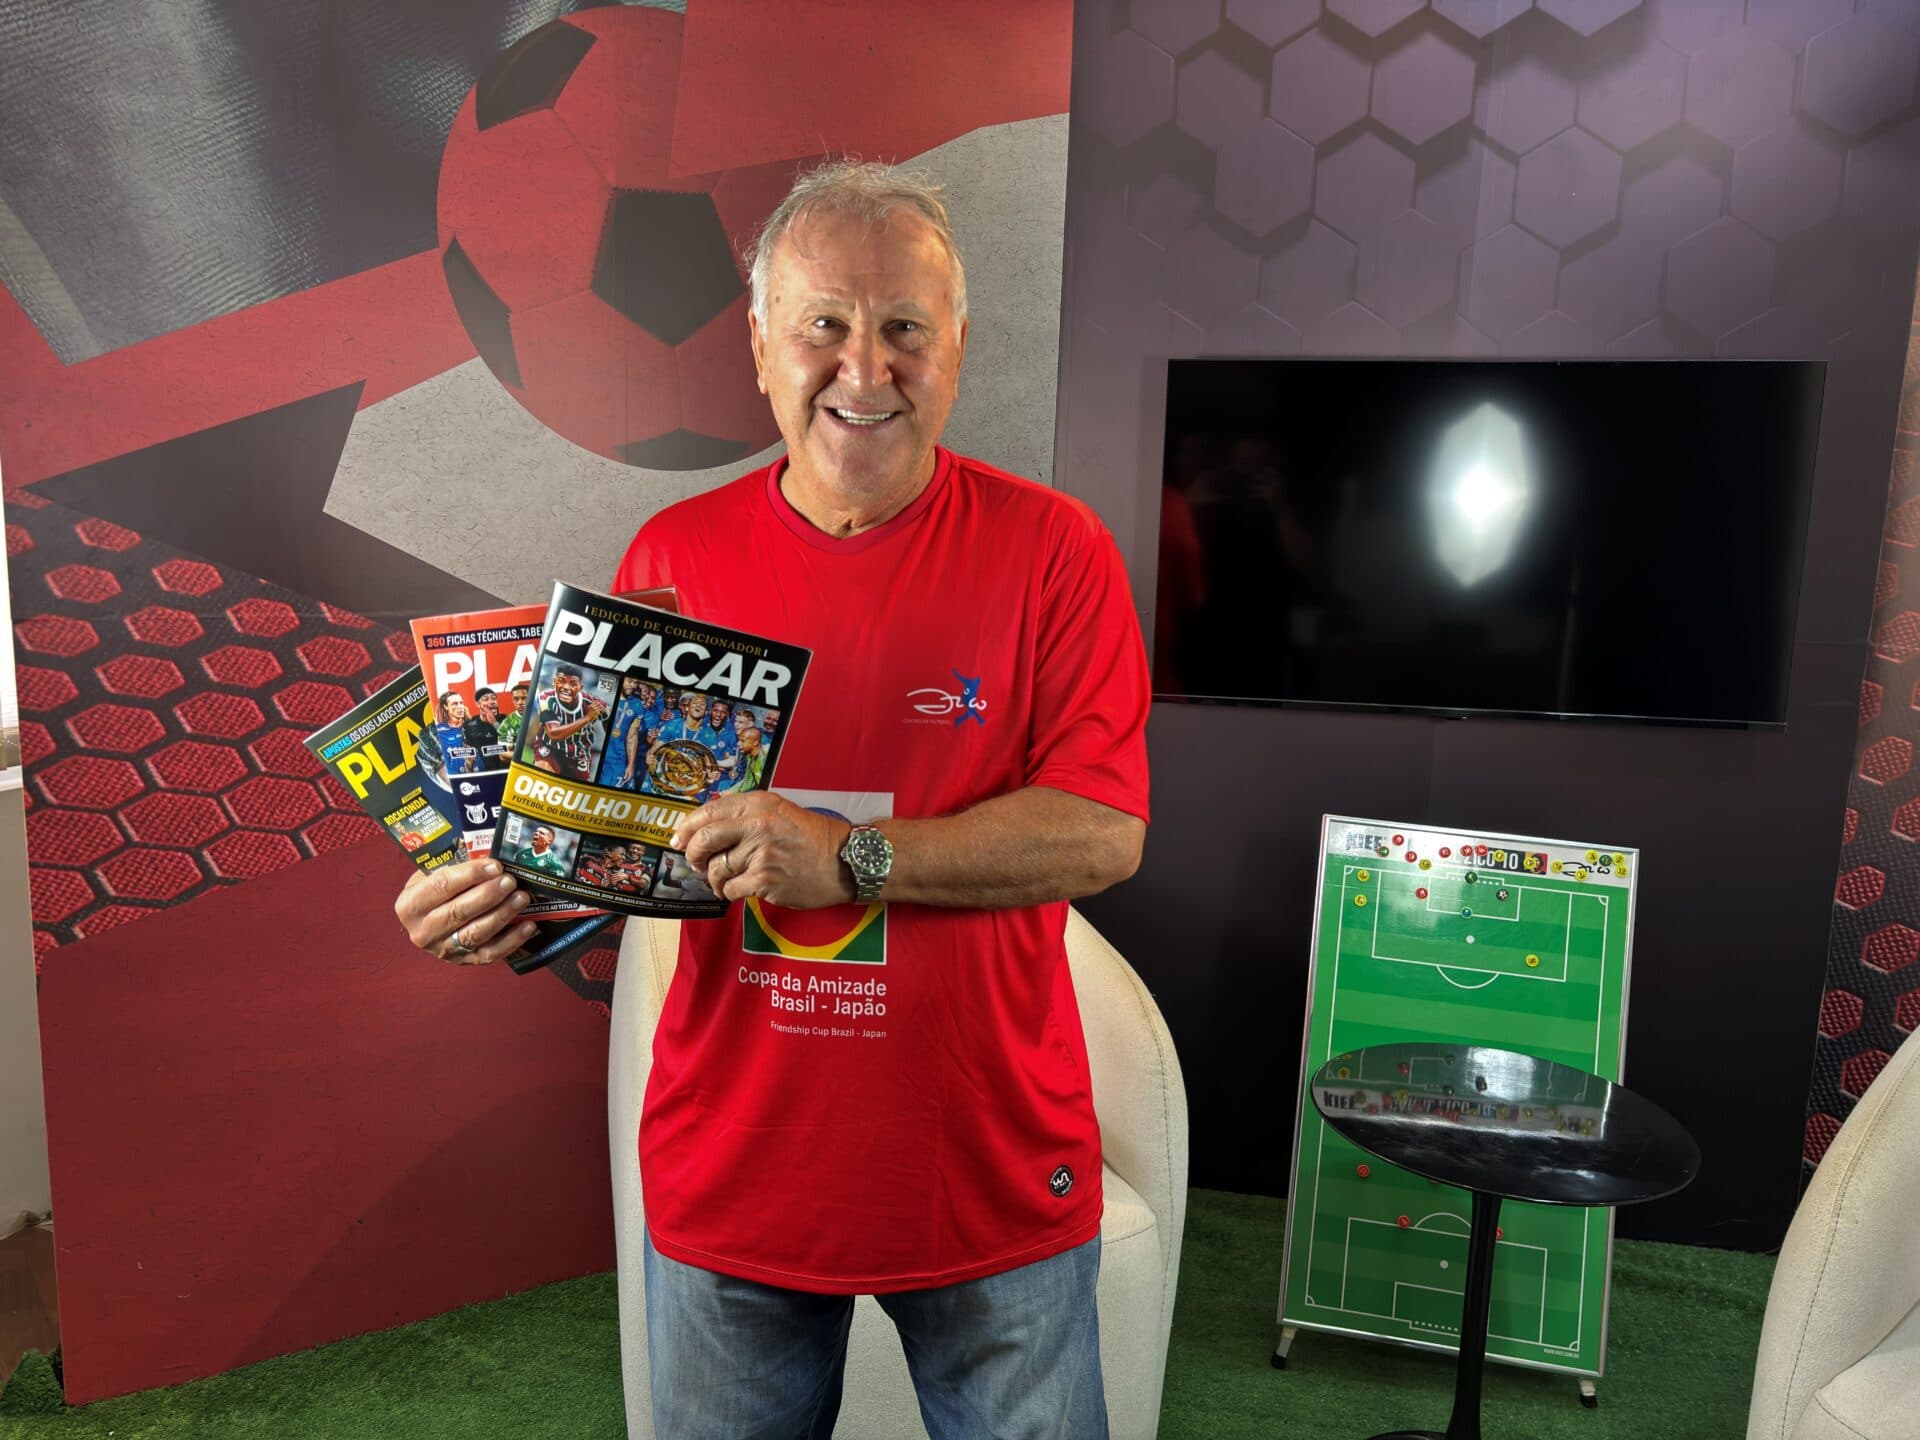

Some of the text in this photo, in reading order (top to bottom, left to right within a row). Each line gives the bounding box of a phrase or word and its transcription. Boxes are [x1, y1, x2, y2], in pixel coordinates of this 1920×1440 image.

[427, 636, 446, 648] 360
[446, 633, 475, 646] FICHAS
[477, 629, 520, 645] TÉCNICAS,
[590, 607, 763, 657] EDIÇÃO DE COLECIONADOR
[433, 643, 539, 699] PLA
[545, 608, 792, 707] PLACAR
[359, 722, 376, 738] DOIS
[373, 707, 397, 731] LADOS
[394, 701, 406, 714] DA
[336, 702, 434, 799] PLA
[384, 796, 428, 826] ROCAFONDA
[512, 795, 544, 811] FUTEBOL
[547, 806, 558, 815] DO
[560, 811, 586, 822] BRASIL
[589, 817, 603, 826] FEZ
[605, 820, 634, 830] BONITO
[514, 775, 632, 820] ORGULHO
[537, 875, 558, 887] FOTOS
[567, 885, 601, 897] CAMPANHA
[738, 966, 887, 996] Copa da Amizade
[771, 990, 815, 1013] Brasil
[833, 996, 886, 1019] Japão
[770, 1020, 810, 1036] Friendship
[812, 1027, 829, 1037] Cup
[831, 1028, 855, 1037] Brazil
[862, 1029, 886, 1039] Japan
